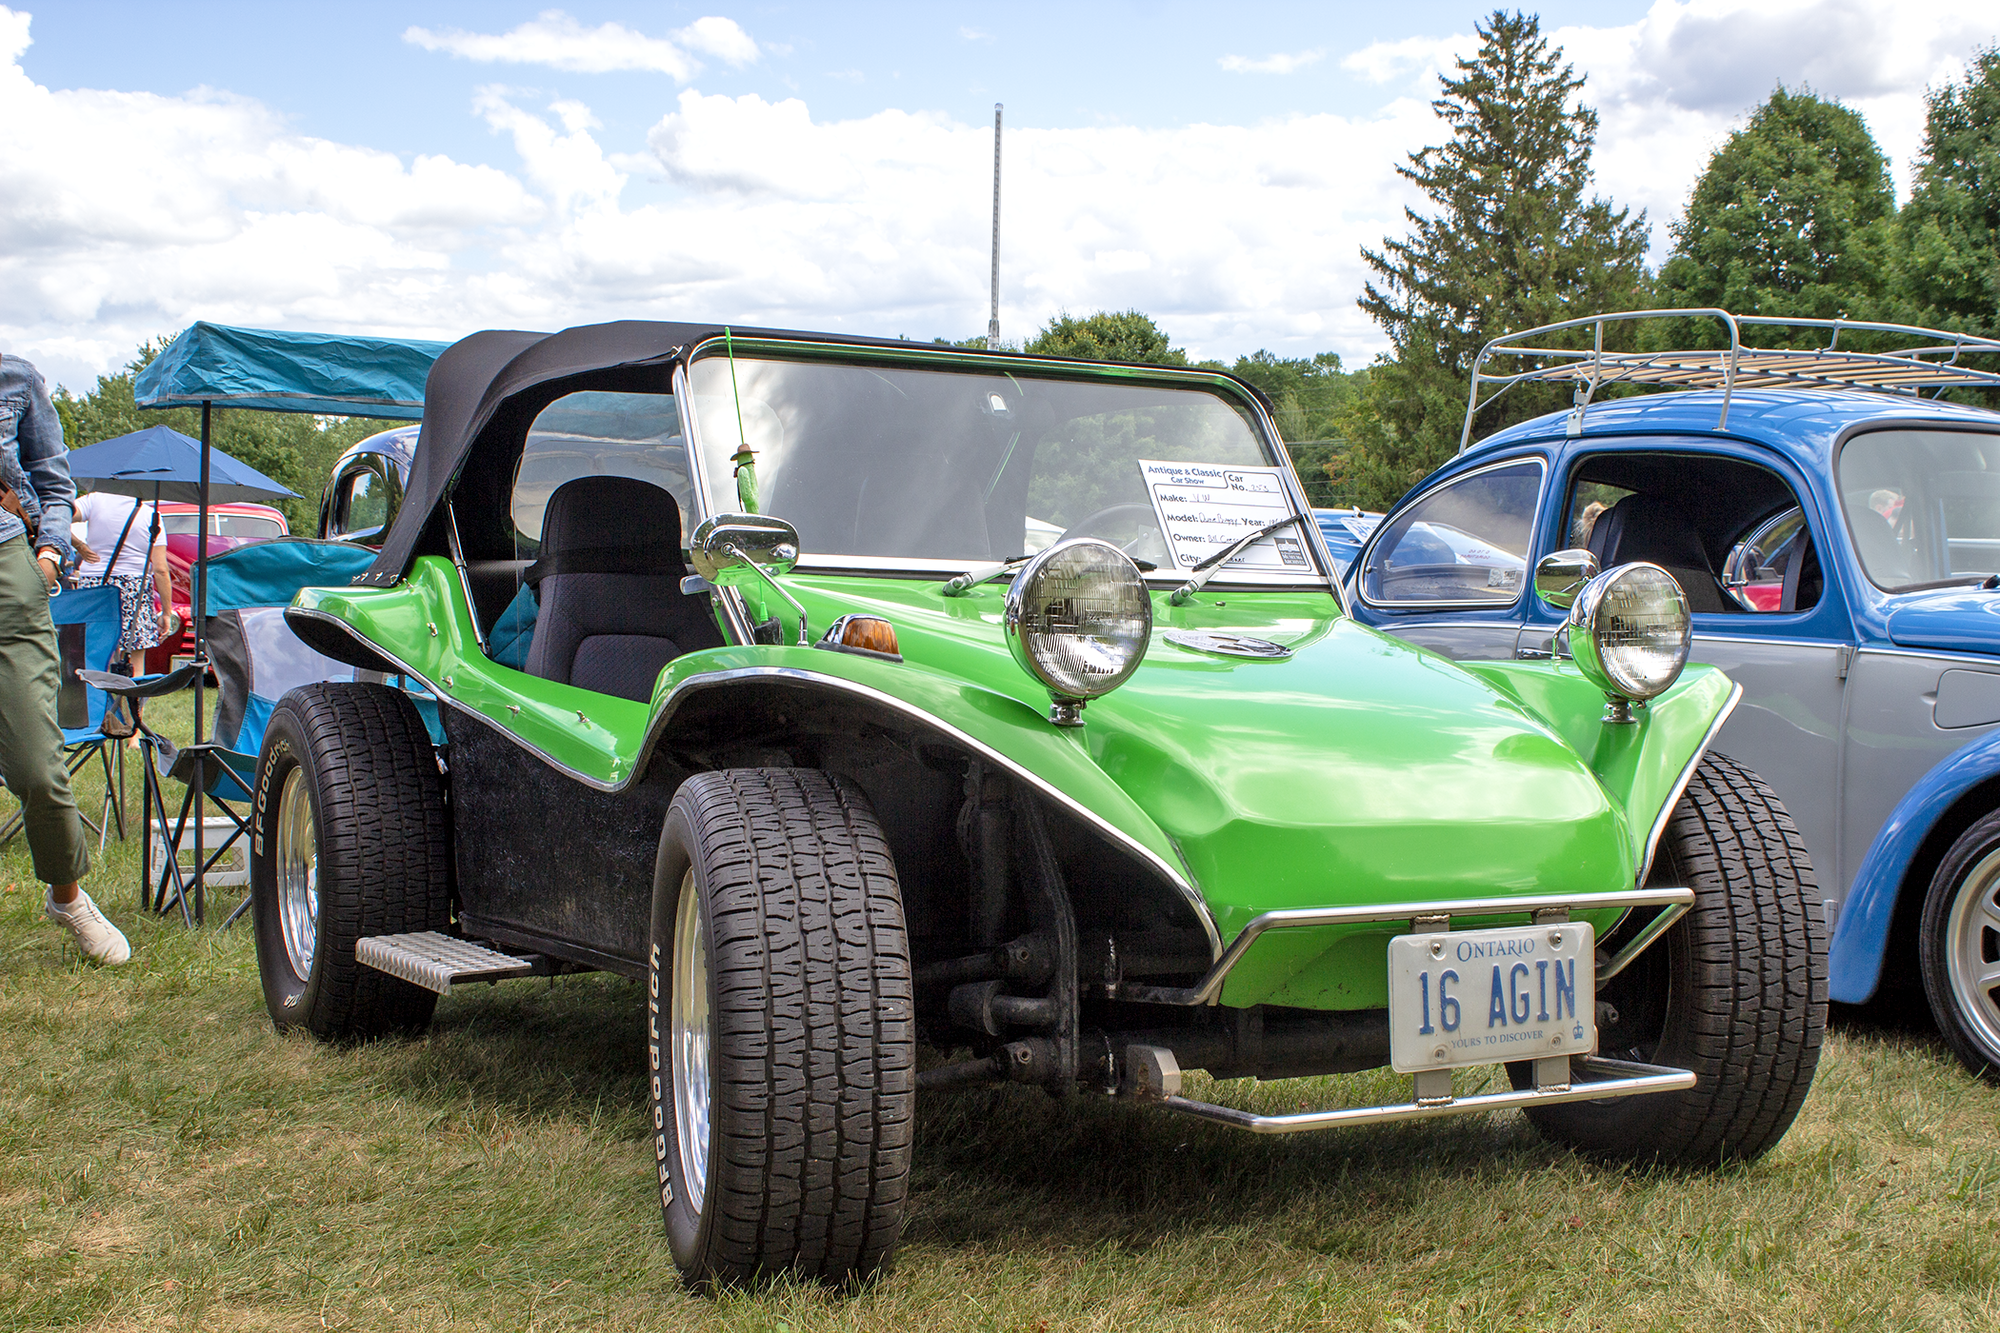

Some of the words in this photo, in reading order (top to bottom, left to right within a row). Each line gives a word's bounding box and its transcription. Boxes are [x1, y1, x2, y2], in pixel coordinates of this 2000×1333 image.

[1148, 465, 1183, 475] Antique
[1191, 467, 1223, 478] Classic
[1228, 474, 1244, 482] Car
[1171, 476, 1183, 484] Car
[1231, 483, 1249, 491] No.
[1160, 493, 1188, 502] Make:
[1167, 514, 1199, 522] Model:
[1241, 517, 1266, 527] Year:
[1173, 533, 1206, 543] Owner:
[1180, 553, 1203, 564] City:
[255, 739, 291, 857] BFGoodrich
[1456, 938, 1536, 962] ONTARIO
[1418, 969, 1461, 1036] 16
[1488, 958, 1576, 1028] AGIN
[1451, 1037, 1482, 1049] YOURS
[1485, 1035, 1498, 1045] TO
[1500, 1030, 1544, 1043] DISCOVER
[650, 944, 674, 1208] BFGoodrich
